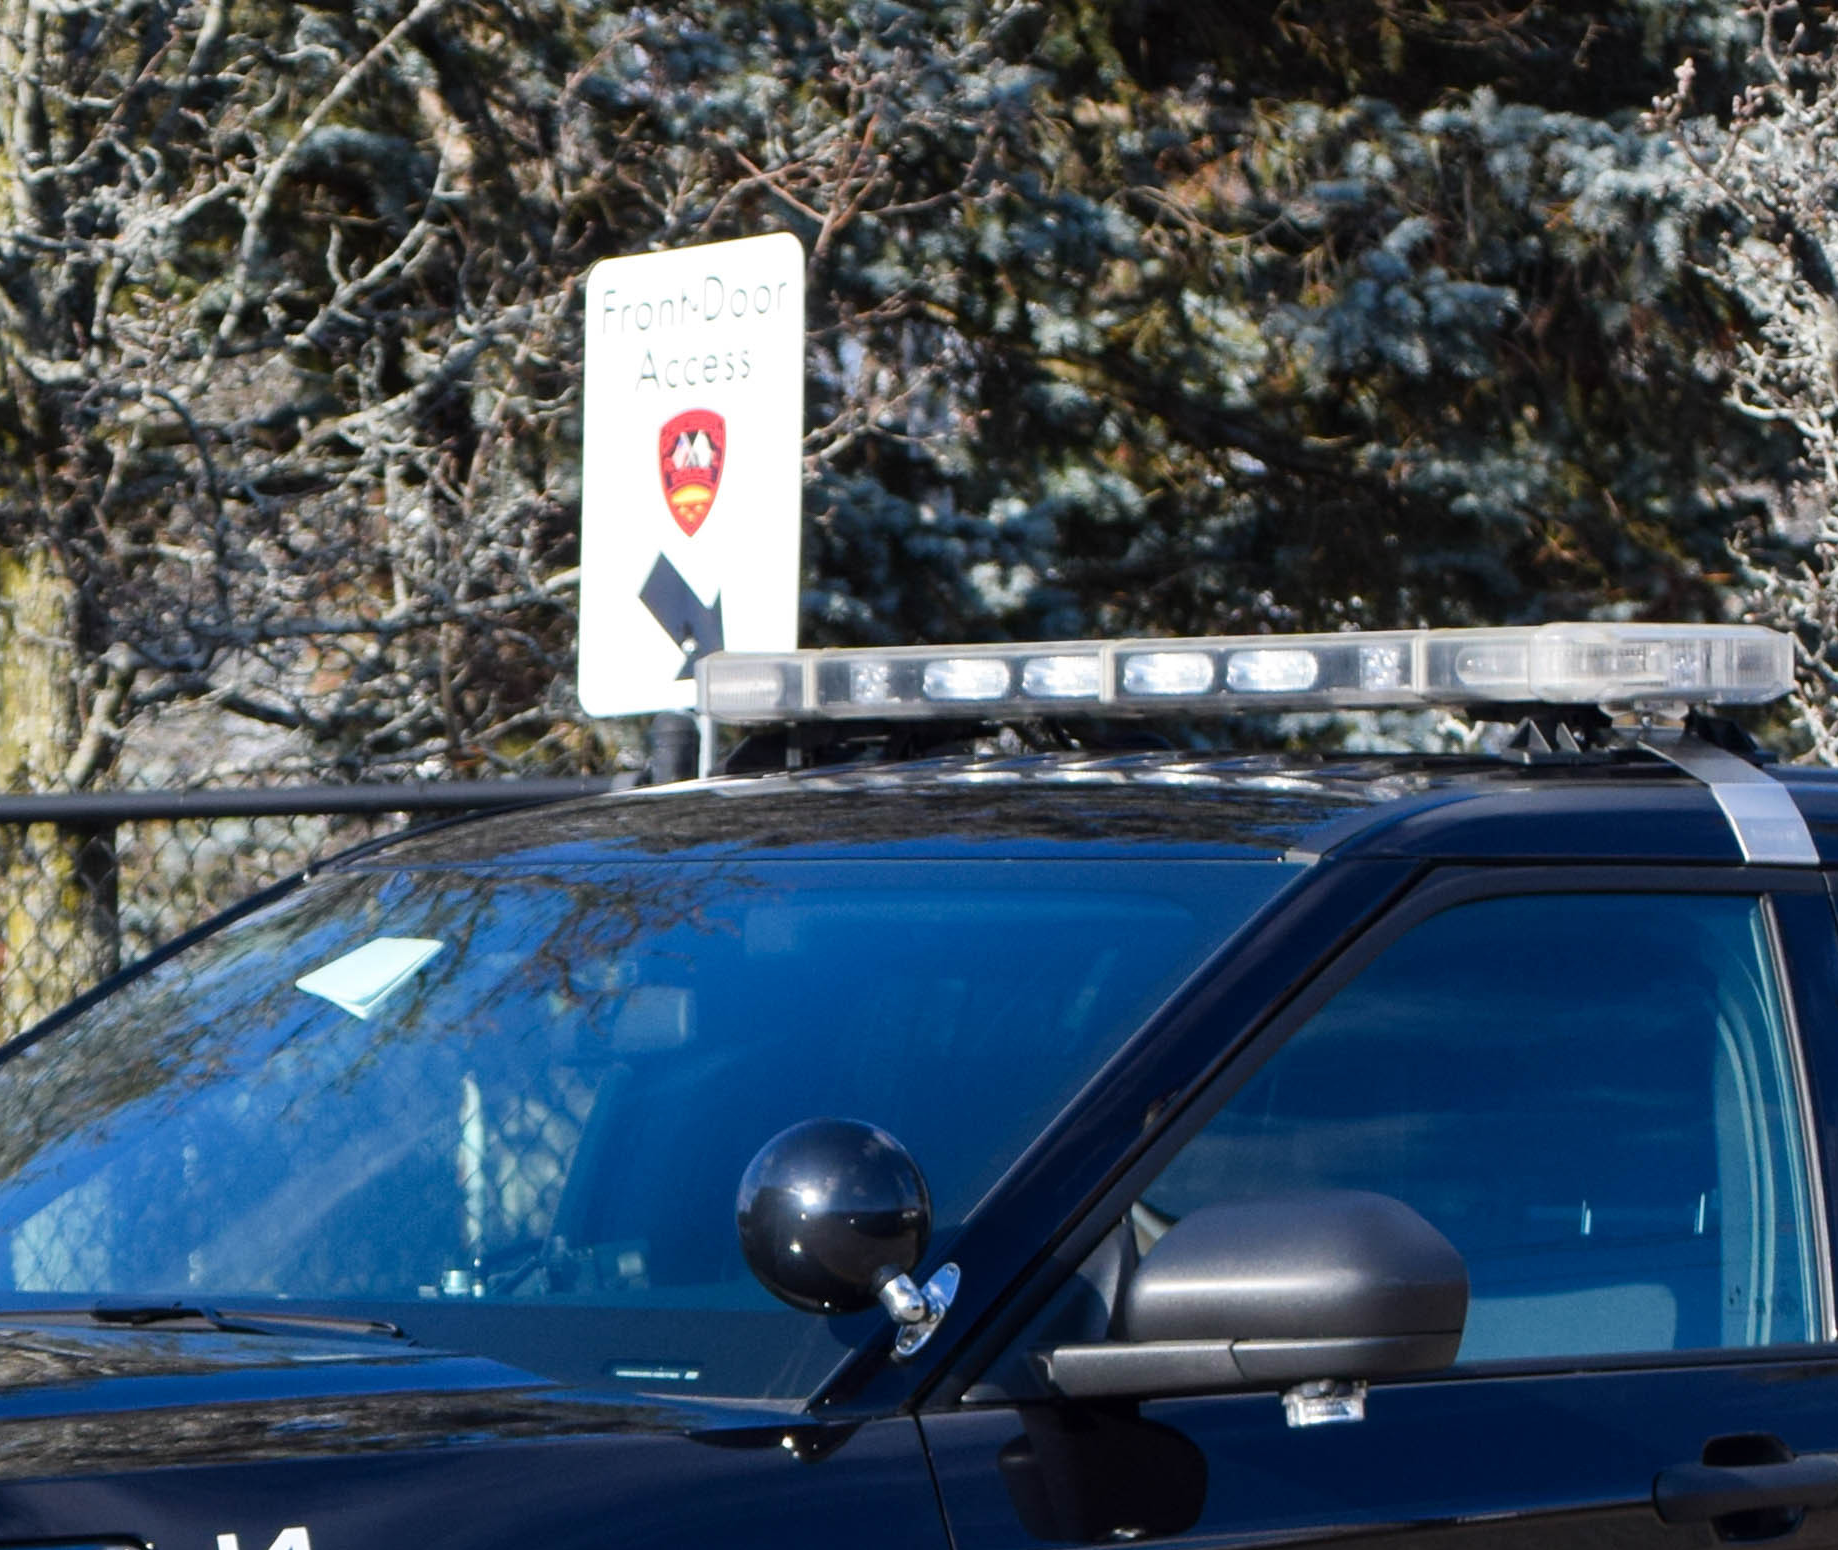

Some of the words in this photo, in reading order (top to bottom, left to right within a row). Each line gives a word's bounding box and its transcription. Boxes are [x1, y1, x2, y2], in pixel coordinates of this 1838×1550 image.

[603, 288, 699, 335] Front
[703, 275, 788, 322] Door
[634, 348, 753, 393] Access
